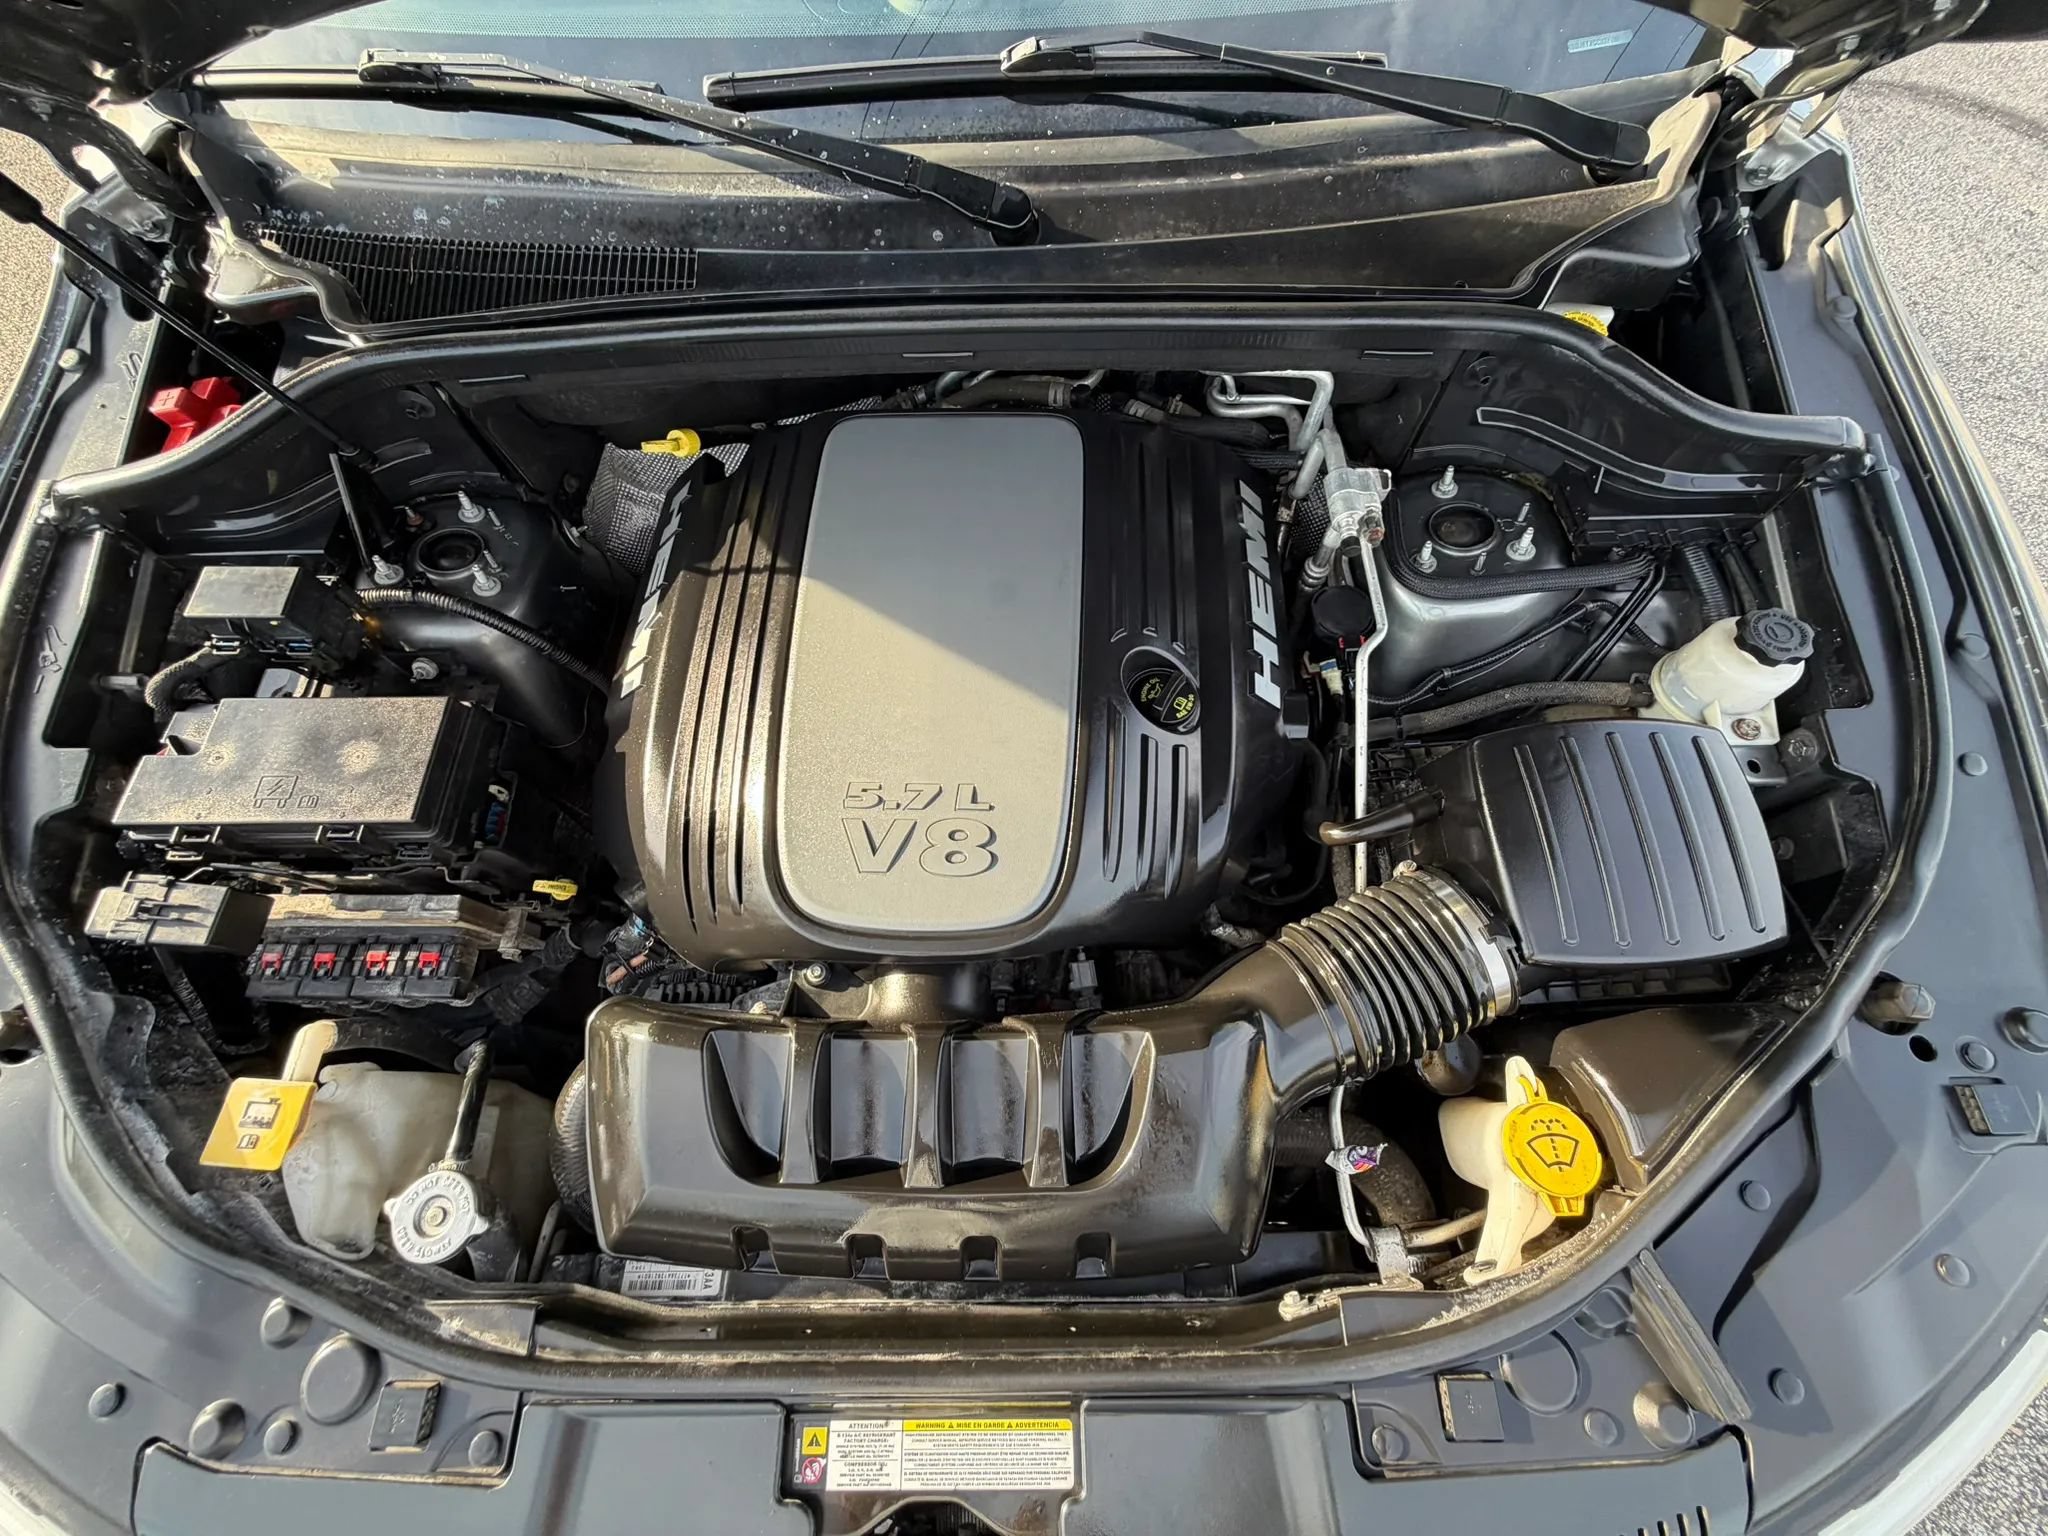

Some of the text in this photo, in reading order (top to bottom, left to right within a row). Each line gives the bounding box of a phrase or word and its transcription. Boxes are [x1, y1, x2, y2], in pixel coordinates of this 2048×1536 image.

[1239, 479, 1281, 709] HEMI
[1140, 682, 1152, 702] ENGINE
[843, 782, 995, 811] 5.7 L
[842, 817, 999, 877] V8
